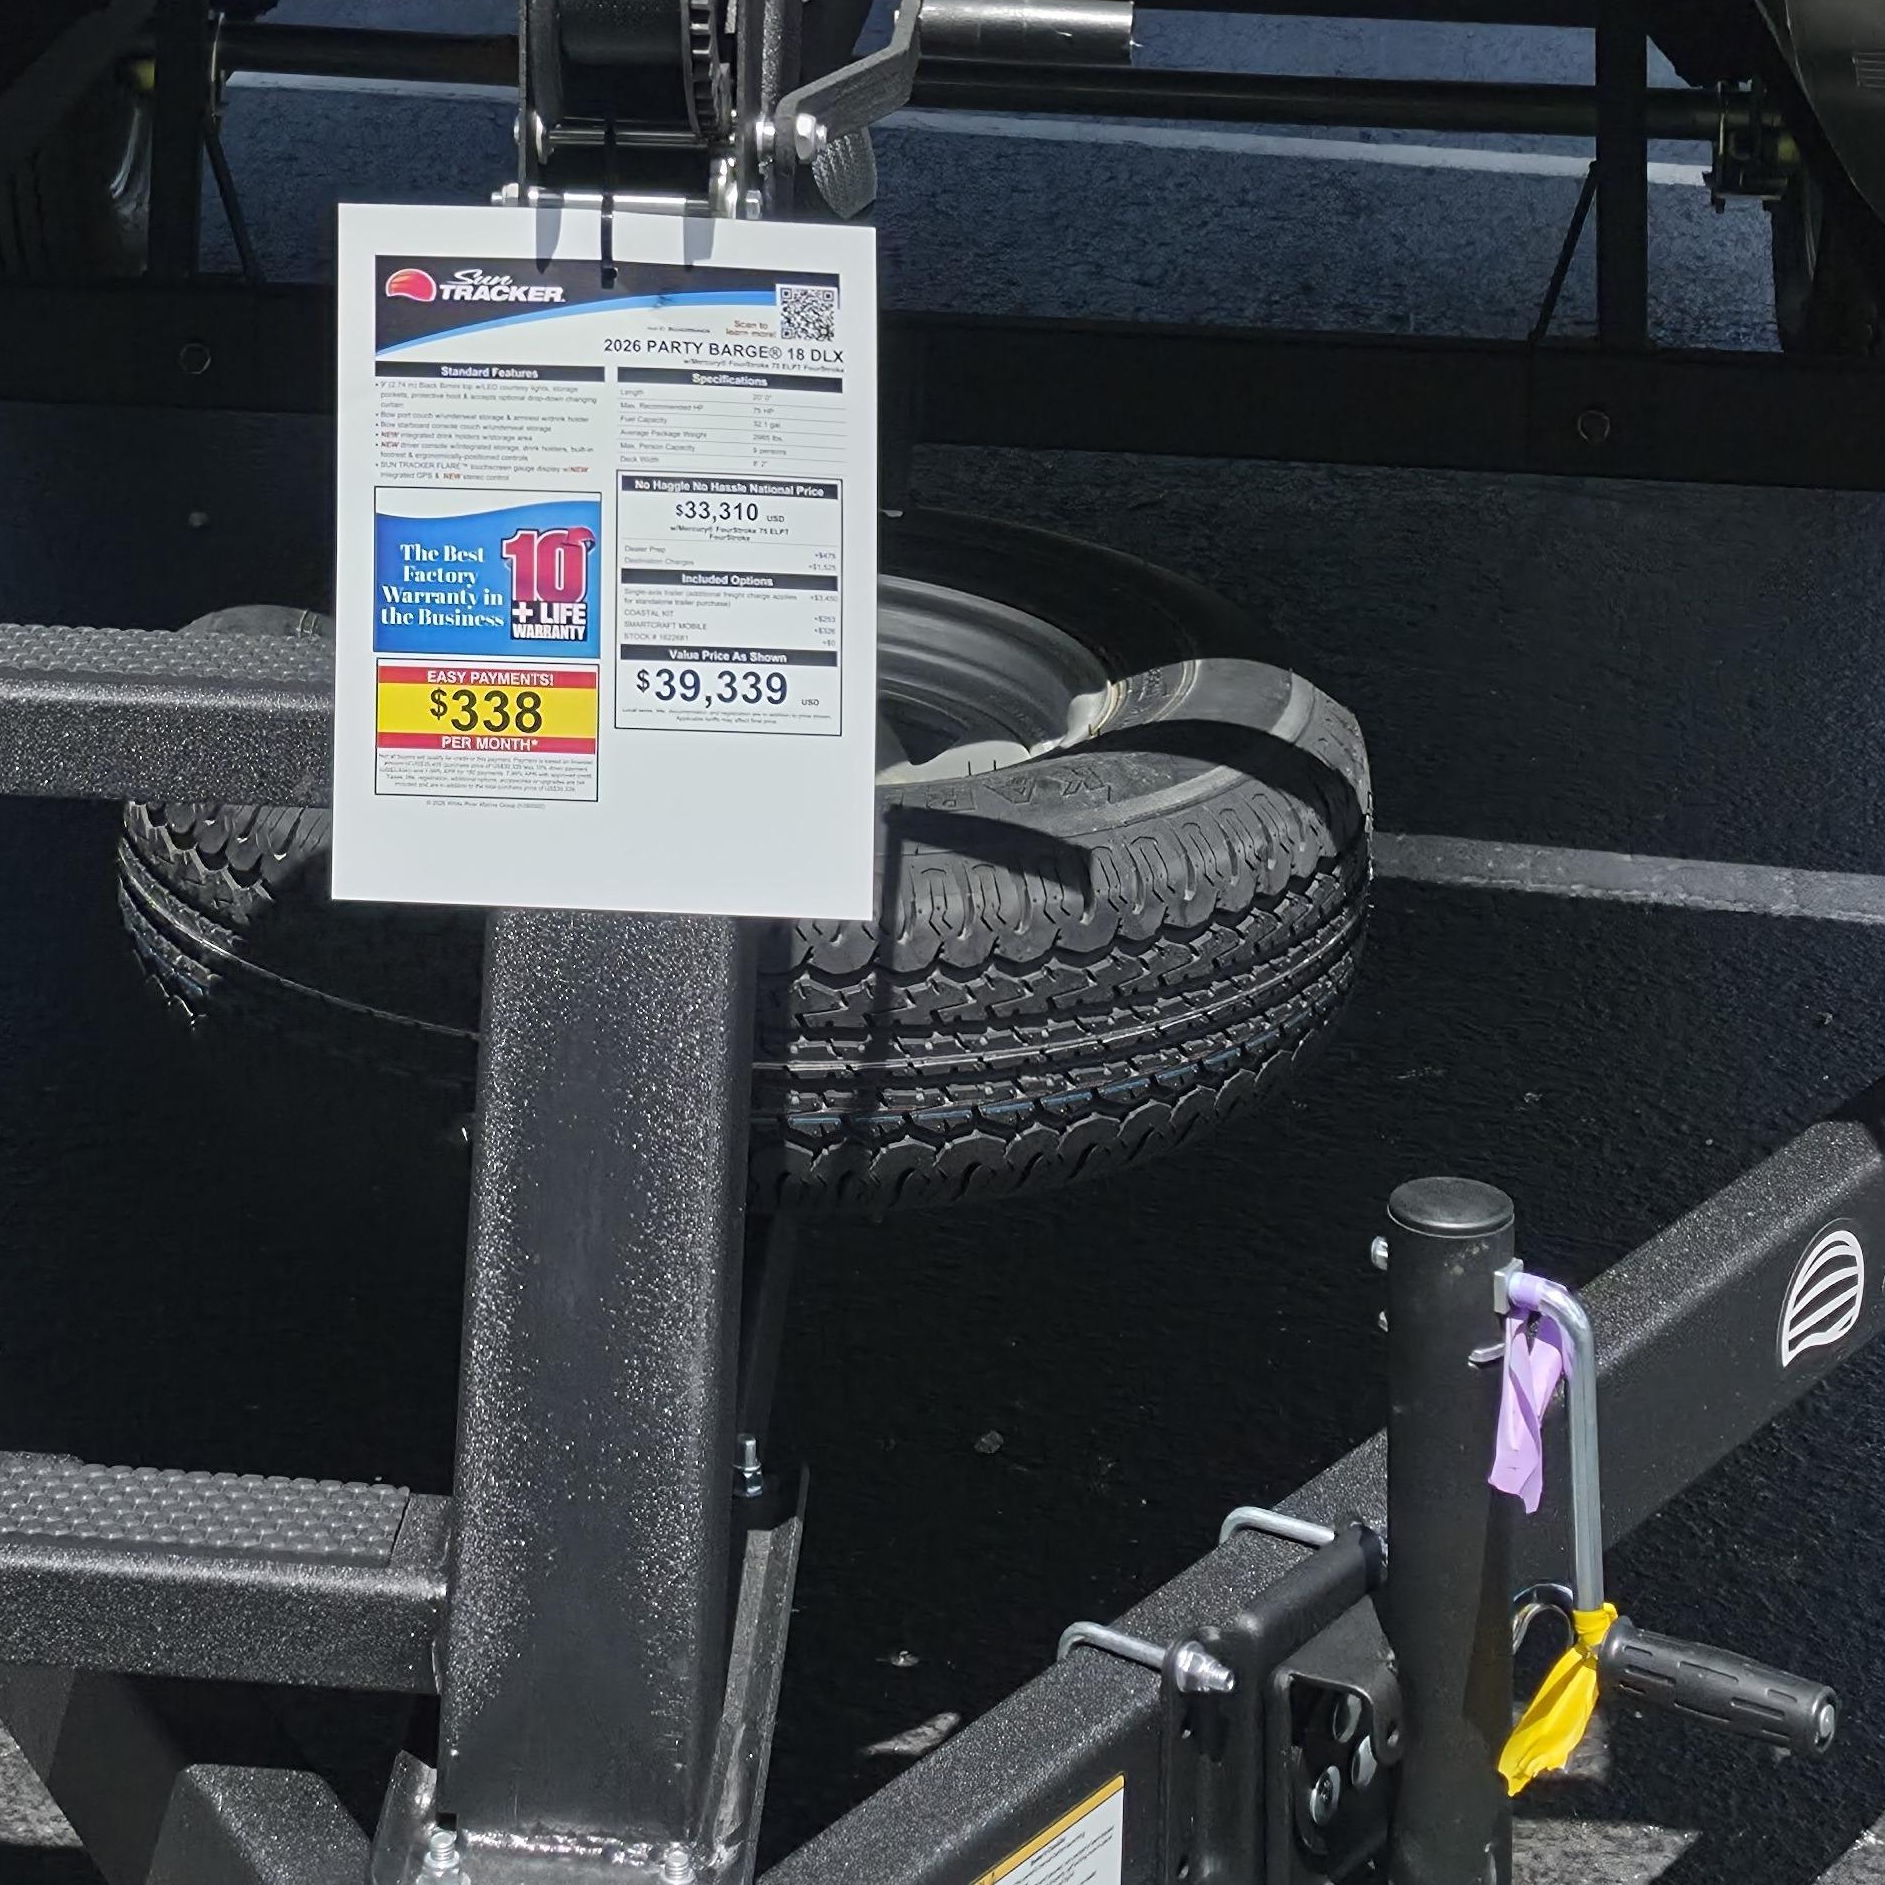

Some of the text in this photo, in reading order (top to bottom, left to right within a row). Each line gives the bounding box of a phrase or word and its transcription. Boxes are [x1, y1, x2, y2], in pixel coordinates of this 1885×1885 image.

[446, 269, 513, 285] Sun
[734, 320, 768, 330] Scan to
[726, 328, 747, 337] learn
[605, 339, 641, 352] 2026
[647, 340, 703, 355] PARTY
[788, 348, 804, 361] 18
[810, 349, 844, 363] DLX
[441, 366, 538, 378] Standard Features
[419, 382, 438, 390] Black
[692, 373, 768, 387] Specifications
[620, 389, 643, 397] Length
[527, 395, 564, 403] drop-down
[565, 396, 597, 404] changing
[639, 403, 691, 411] Recommended
[479, 414, 504, 422] storage
[637, 417, 667, 425] Capacity
[401, 433, 434, 441] integrated
[620, 430, 648, 438] Average
[651, 431, 681, 439] Package
[666, 444, 695, 452] Capacity
[634, 479, 824, 497] No Haggle No Hassle National Price
[675, 501, 759, 524] $33,310
[716, 526, 756, 534] FourStroke
[709, 534, 750, 542] FourStroke
[400, 544, 484, 563] The Best
[501, 527, 589, 602] 10
[665, 558, 694, 566] Charges
[403, 565, 478, 588] Factory
[682, 573, 773, 587] Included Options
[382, 585, 503, 609] Warranty in
[723, 592, 745, 600] freight
[747, 593, 771, 601] charge
[773, 594, 798, 602] applies
[381, 607, 504, 627] the Business
[541, 602, 587, 625] LIFE
[624, 609, 660, 617] COASTAL
[513, 623, 586, 640] WARRANTY
[624, 621, 676, 630] SMARTCRAFT
[624, 633, 651, 641] STOCK
[668, 648, 787, 663] Value Price As Shown
[427, 670, 554, 687] EASY PAYMENTS!
[636, 669, 788, 709] $39,339
[429, 687, 543, 734] $338
[442, 736, 471, 749] PER
